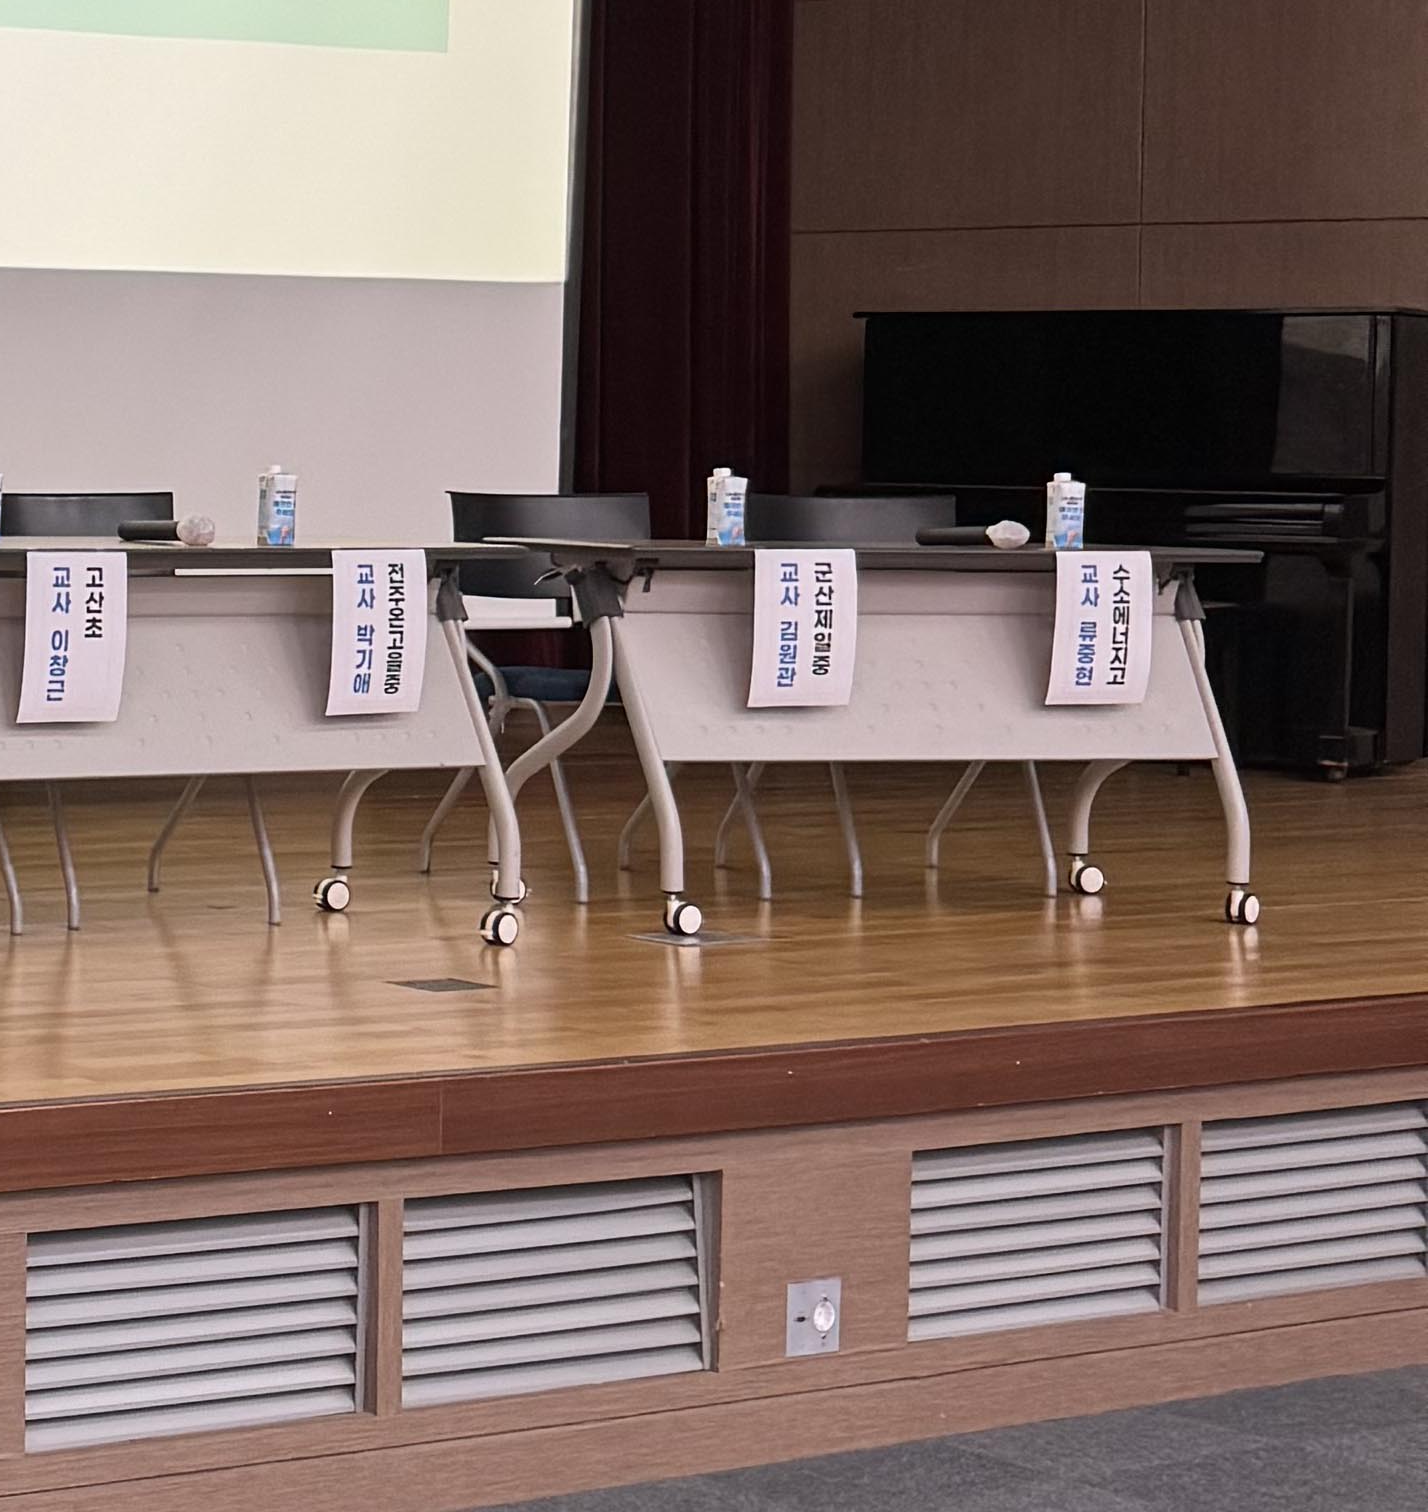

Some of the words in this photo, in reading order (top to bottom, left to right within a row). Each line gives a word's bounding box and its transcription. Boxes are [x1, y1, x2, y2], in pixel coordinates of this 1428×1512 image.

[53, 568, 71, 613] 교사
[85, 568, 103, 638] 고산초
[357, 565, 374, 608] 교사
[781, 563, 799, 606] 교사
[1081, 565, 1099, 606] 교사
[385, 563, 405, 694] 전주온고을중
[813, 563, 834, 675] 군산제일중
[1107, 564, 1130, 685] 수소에너지고
[47, 630, 68, 701] 이창근
[354, 625, 374, 694] 박기애
[777, 622, 797, 687] 김원관
[1076, 622, 1097, 686] 류중현
